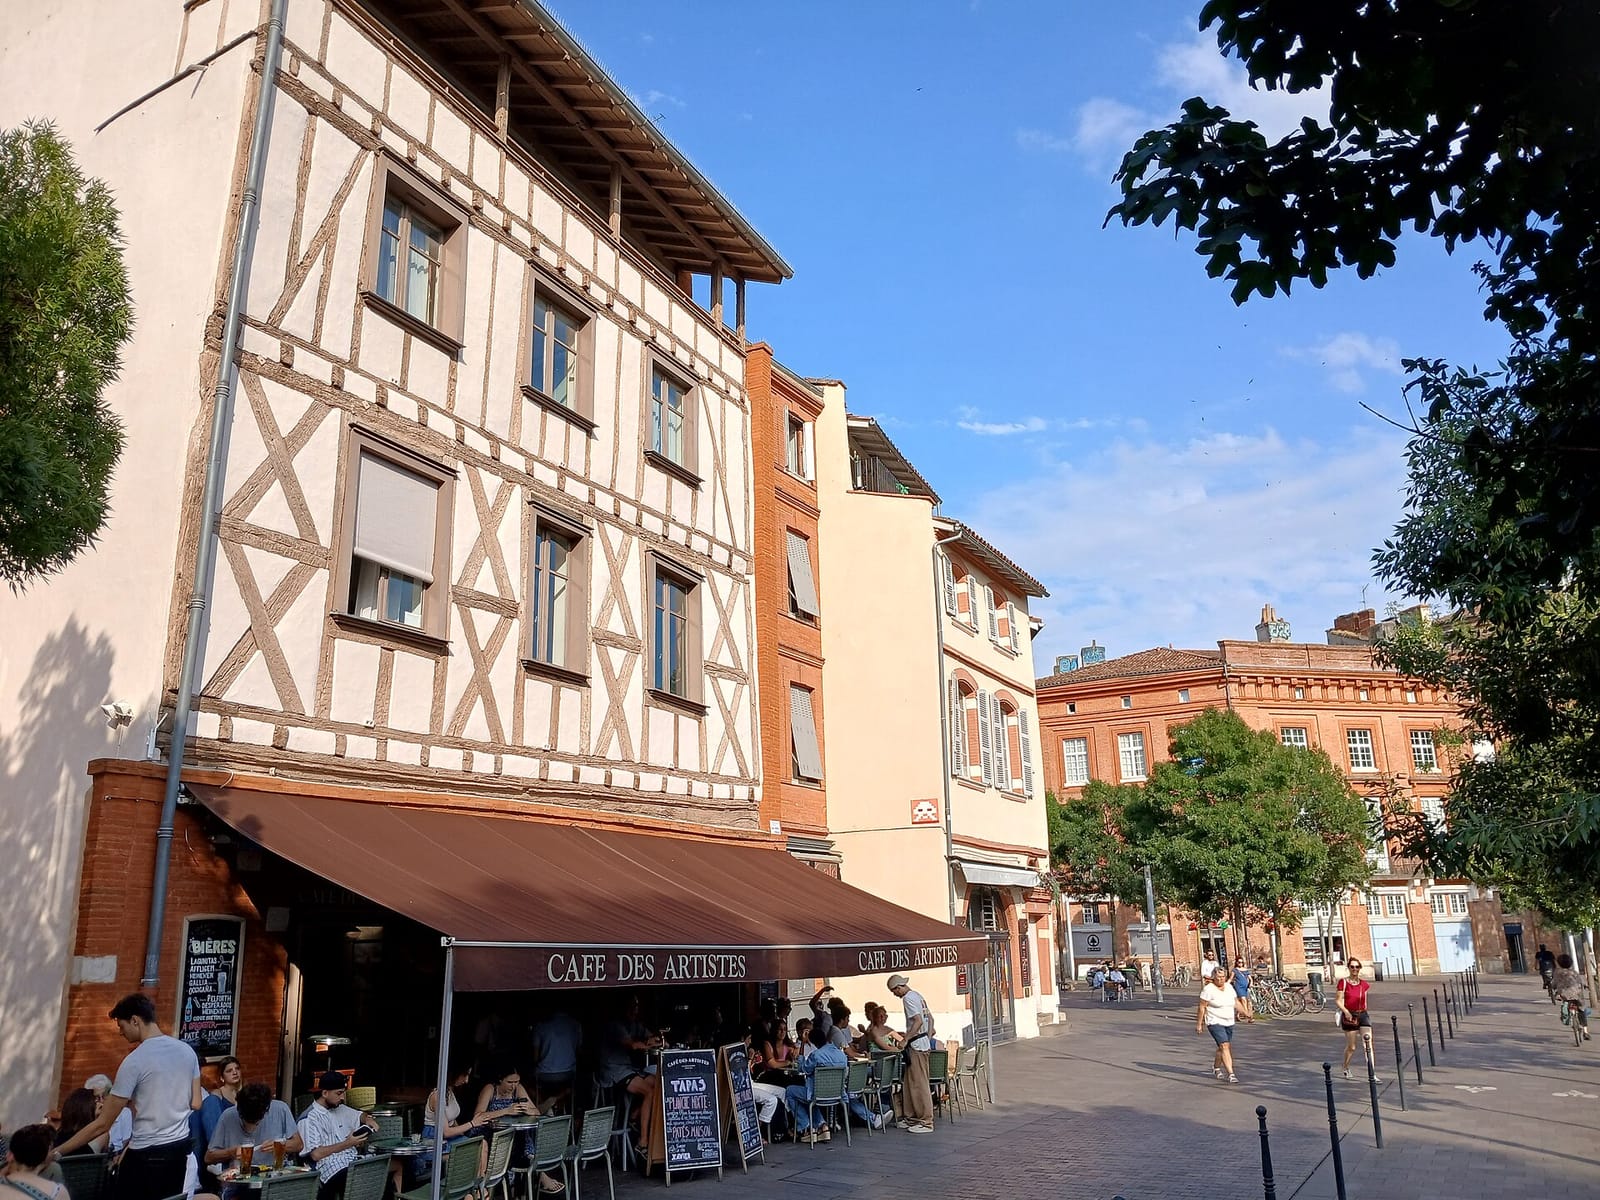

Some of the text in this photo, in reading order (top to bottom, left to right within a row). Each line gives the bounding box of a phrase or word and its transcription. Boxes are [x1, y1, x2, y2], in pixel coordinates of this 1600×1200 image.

[191, 937, 236, 954] BIÈRES
[547, 953, 746, 983] CAFE DES ARTISTES
[858, 945, 958, 971] CAFE DES ARTISTES
[670, 1079, 707, 1092] TAPAS
